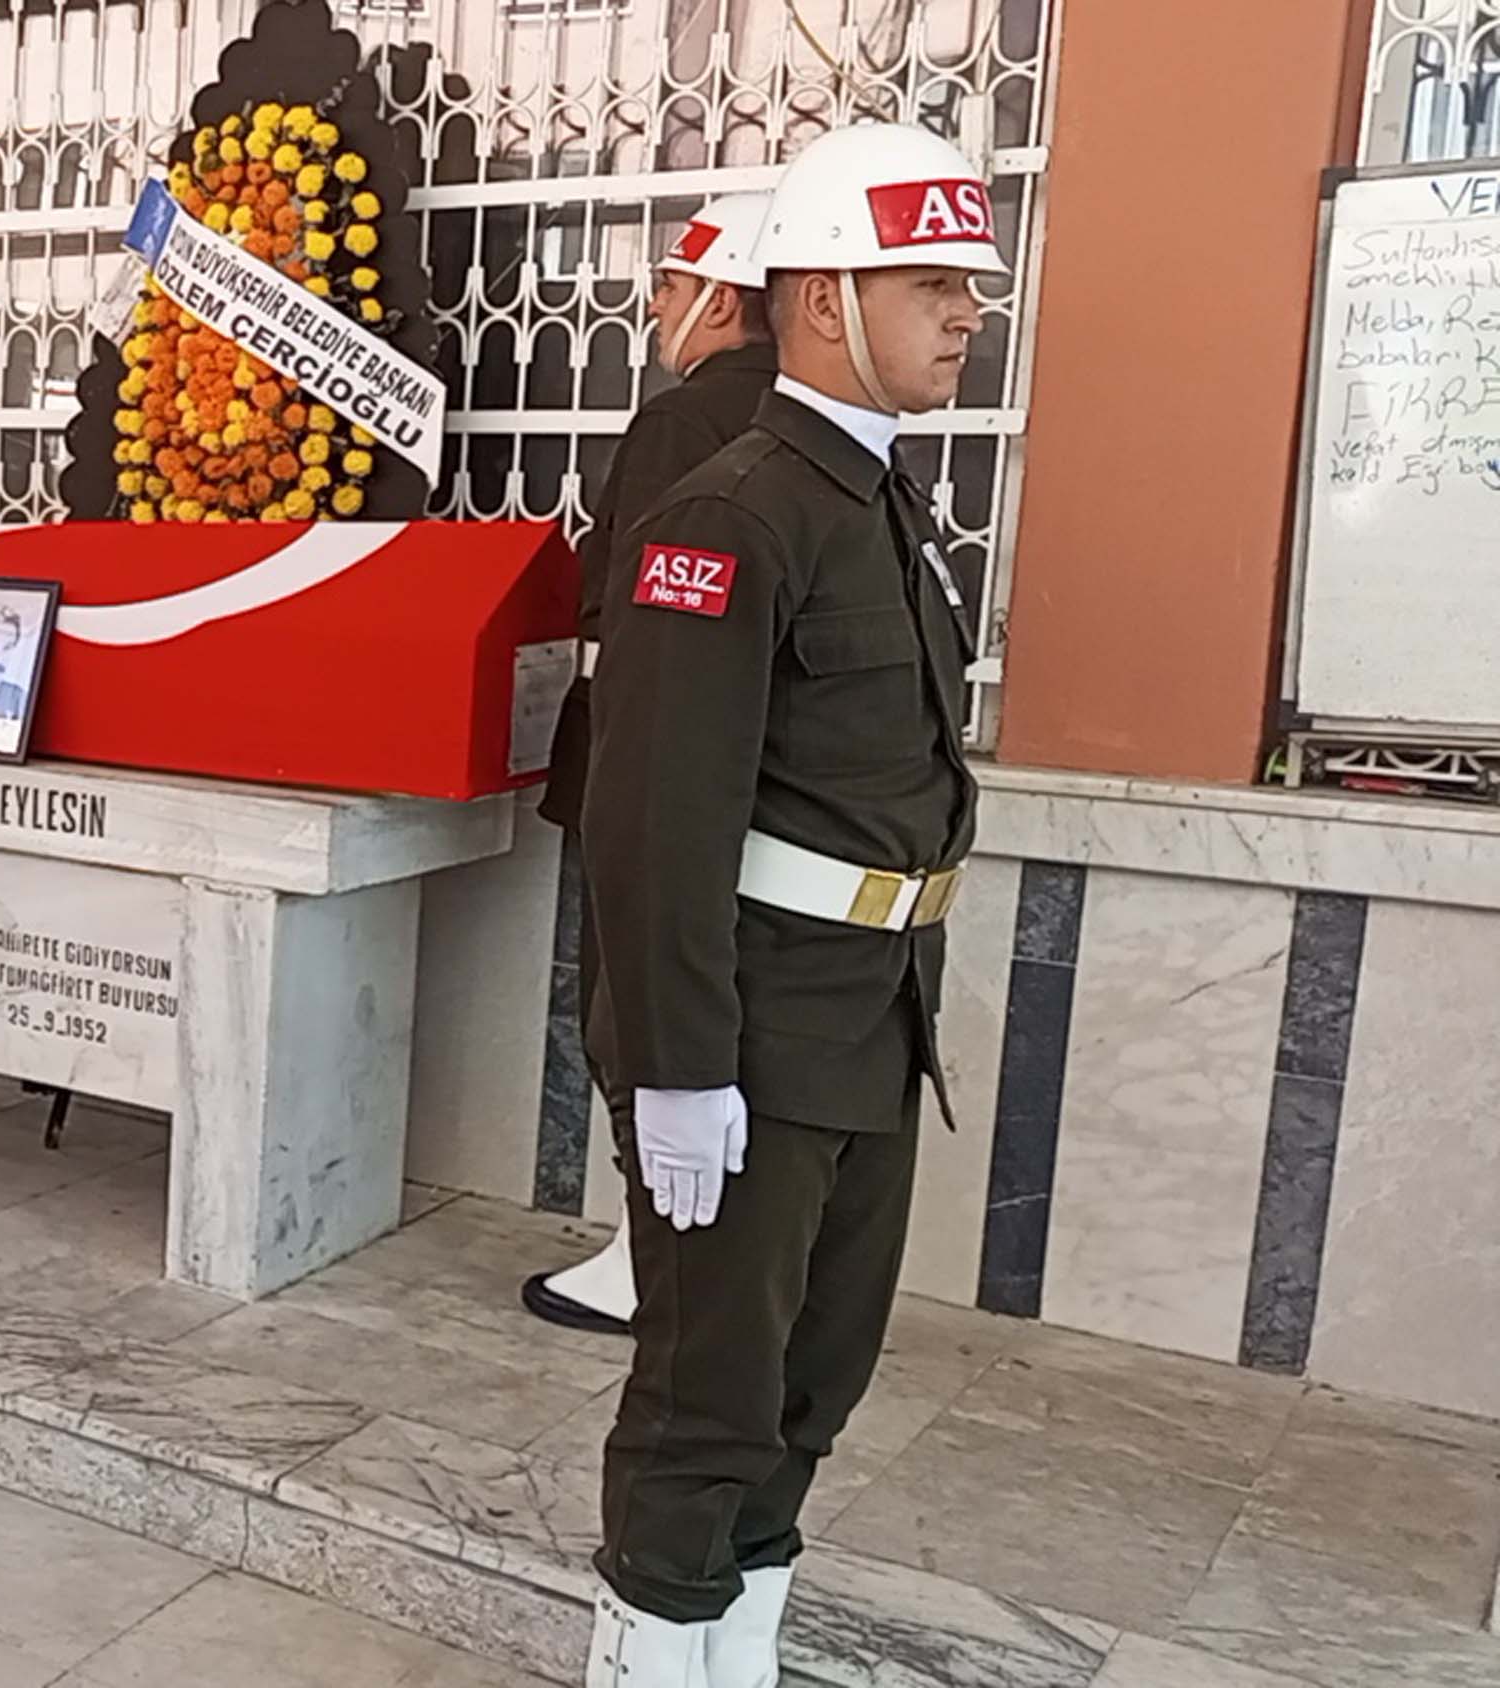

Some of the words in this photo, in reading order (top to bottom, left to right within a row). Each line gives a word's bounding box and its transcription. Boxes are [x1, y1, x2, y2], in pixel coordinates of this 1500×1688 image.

[1430, 177, 1500, 216] VE
[192, 242, 288, 321] BÜYÜKŞEHİR
[281, 301, 367, 371] BELEDİYE
[157, 254, 227, 323] ÖZLEM
[230, 313, 424, 448] ÇERÇİOĞLU
[0, 784, 107, 838] EYLESİN
[64, 941, 172, 981] GİDİYORSUN
